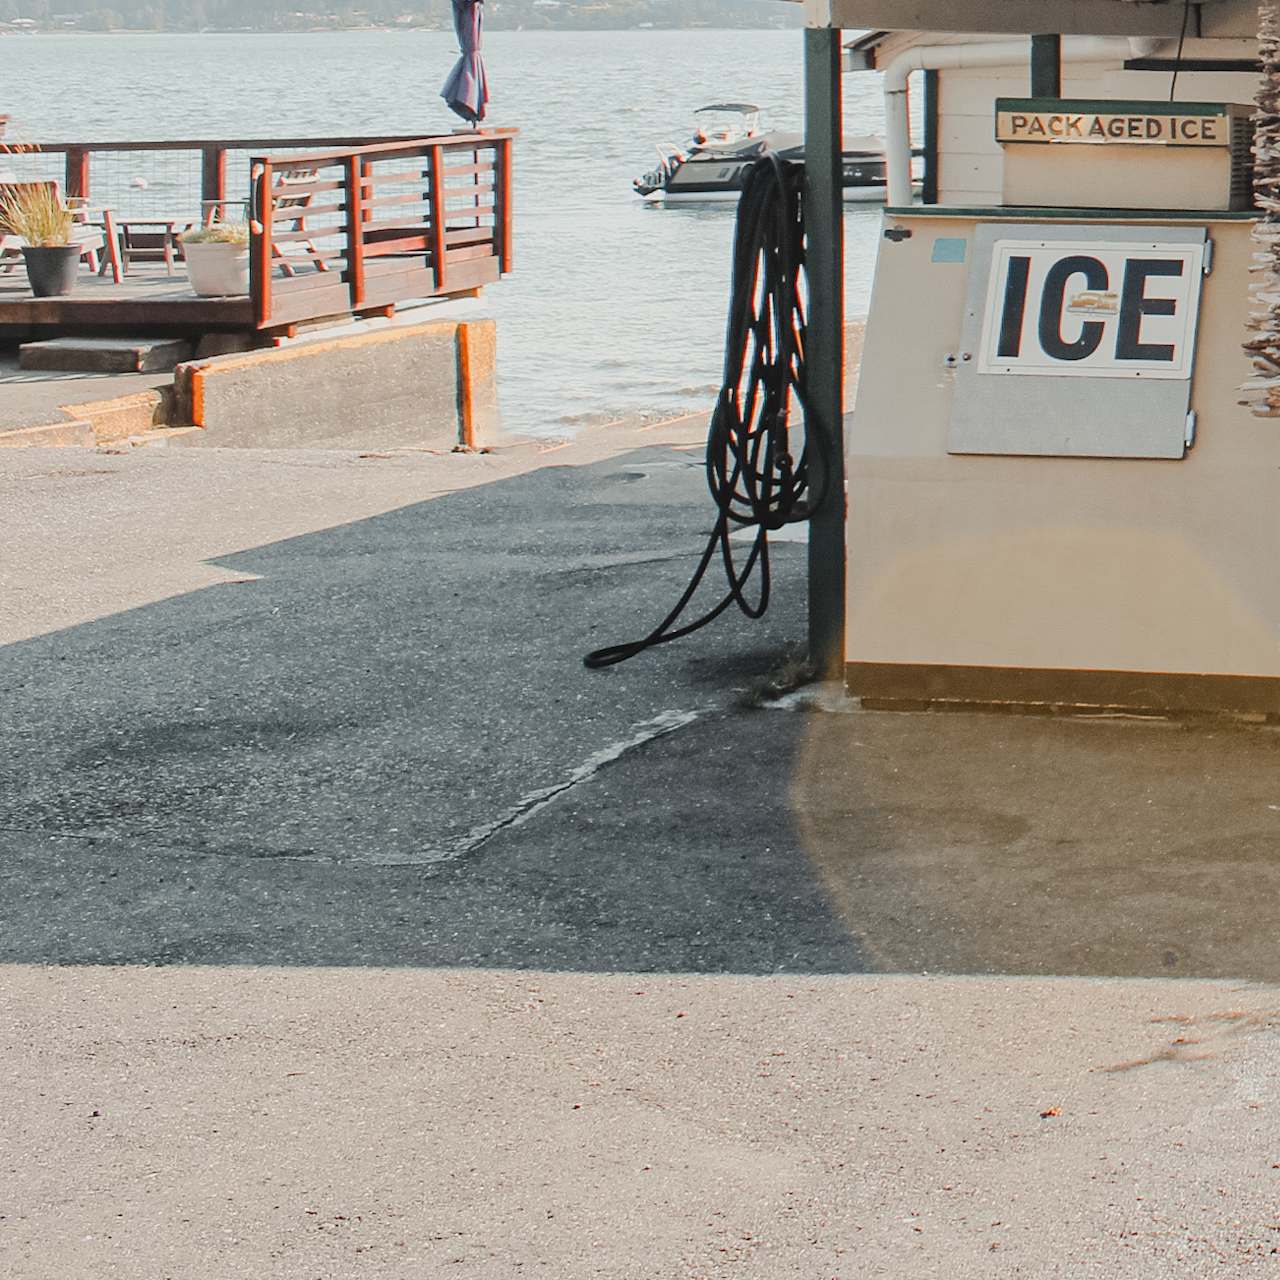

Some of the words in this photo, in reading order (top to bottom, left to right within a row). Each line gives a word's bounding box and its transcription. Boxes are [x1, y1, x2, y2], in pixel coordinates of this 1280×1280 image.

[1011, 116, 1162, 139] PACKAGED
[1170, 118, 1217, 140] ICE
[997, 255, 1184, 362] ICE
